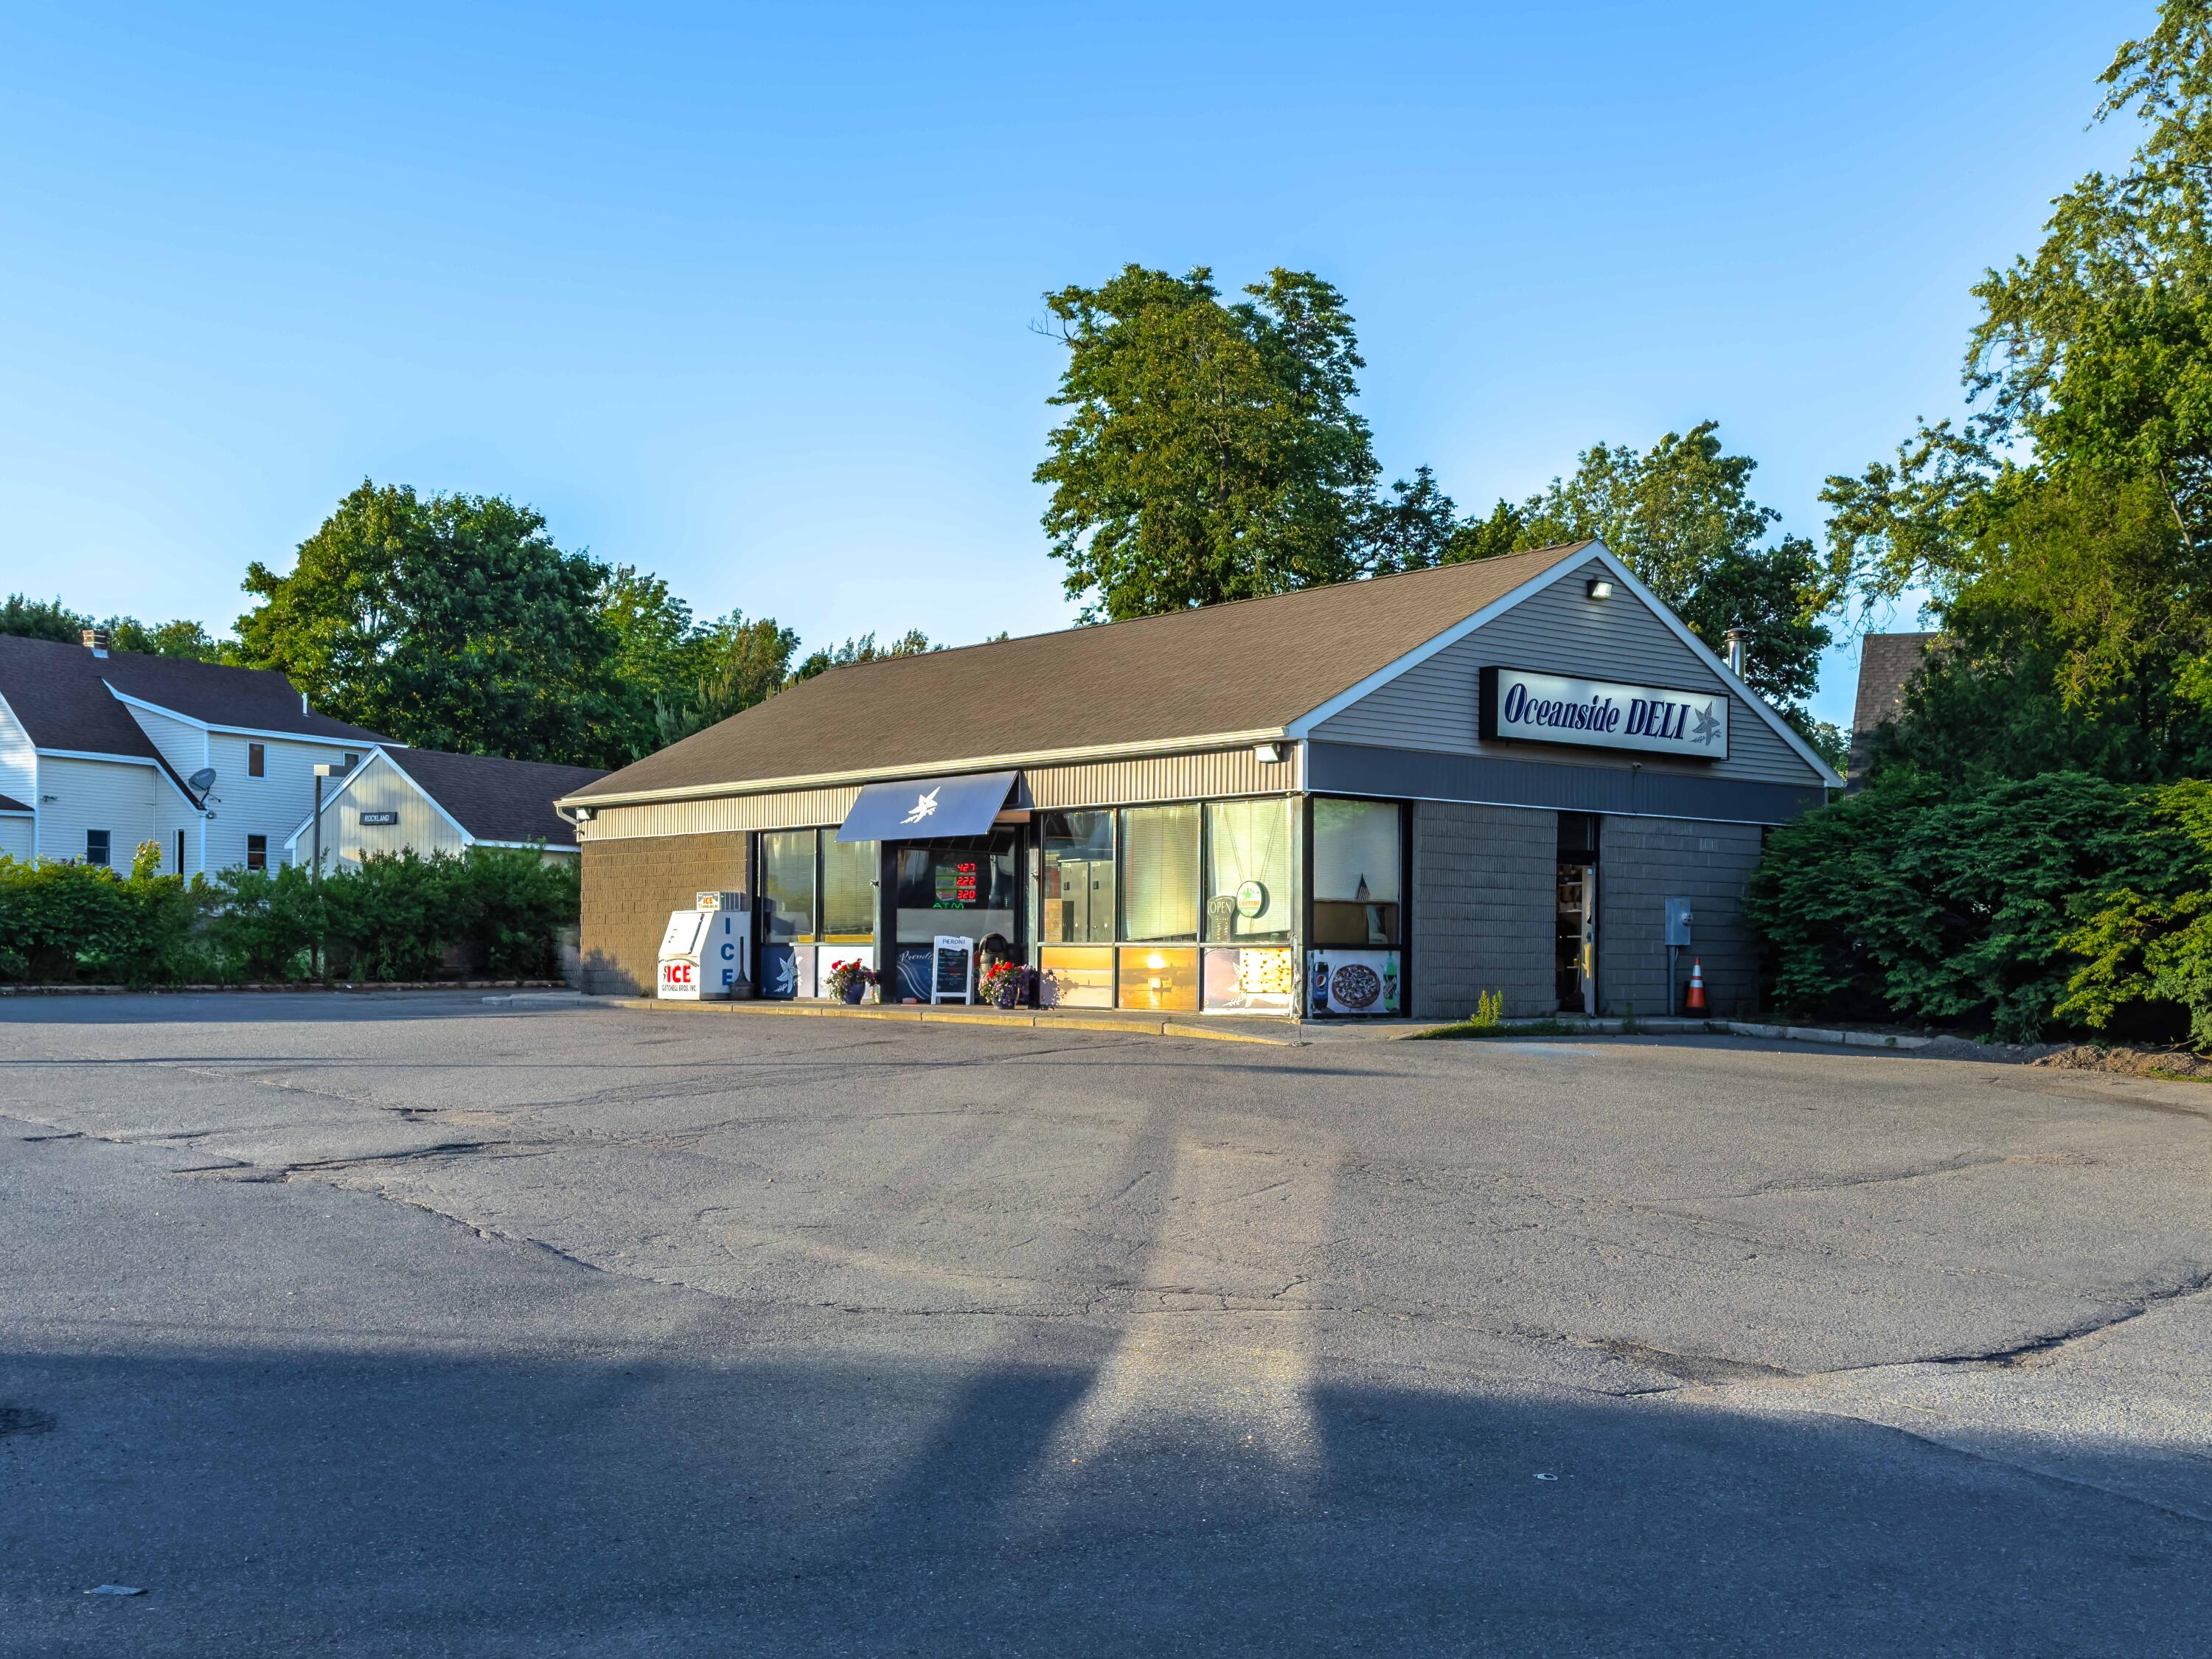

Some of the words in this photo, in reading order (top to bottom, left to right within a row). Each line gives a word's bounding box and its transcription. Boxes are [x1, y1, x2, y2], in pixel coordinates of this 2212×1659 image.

[1504, 683, 1620, 733] Oceanside
[1624, 698, 1691, 740] DELI
[364, 814, 390, 822] ROCKLAND
[1210, 901, 1231, 914] OPEN
[720, 917, 734, 986] ICE
[667, 964, 692, 983] ICE
